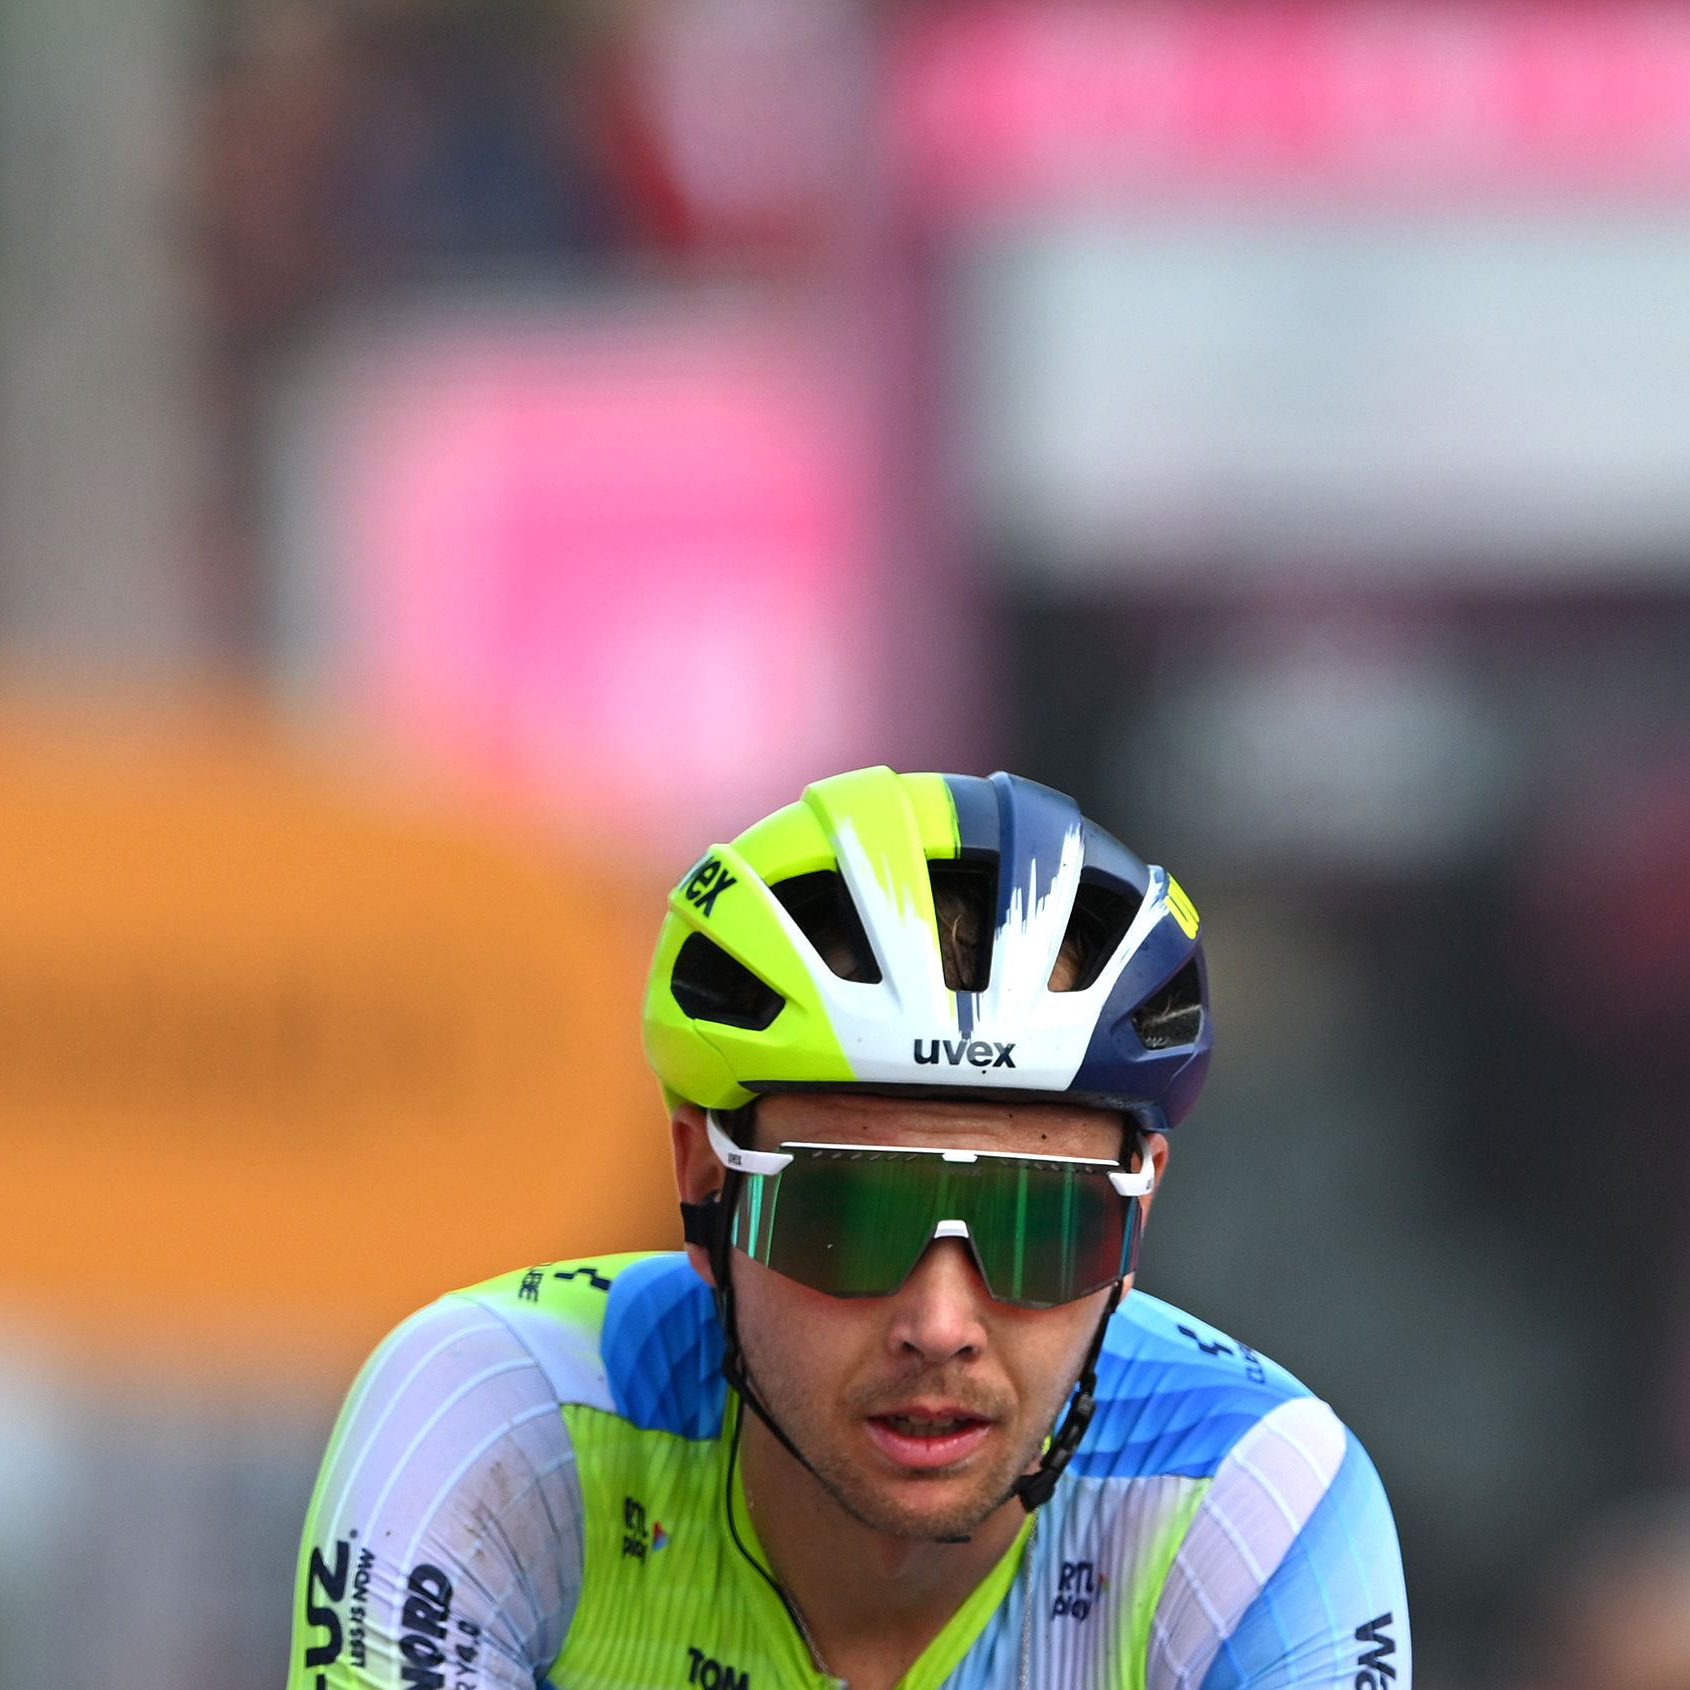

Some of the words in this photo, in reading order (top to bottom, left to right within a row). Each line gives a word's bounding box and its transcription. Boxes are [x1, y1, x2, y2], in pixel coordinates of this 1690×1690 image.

[914, 1038, 1017, 1069] uvex
[353, 1548, 376, 1603] NOW
[1058, 1562, 1094, 1593] RTL
[348, 1618, 366, 1668] LESS
